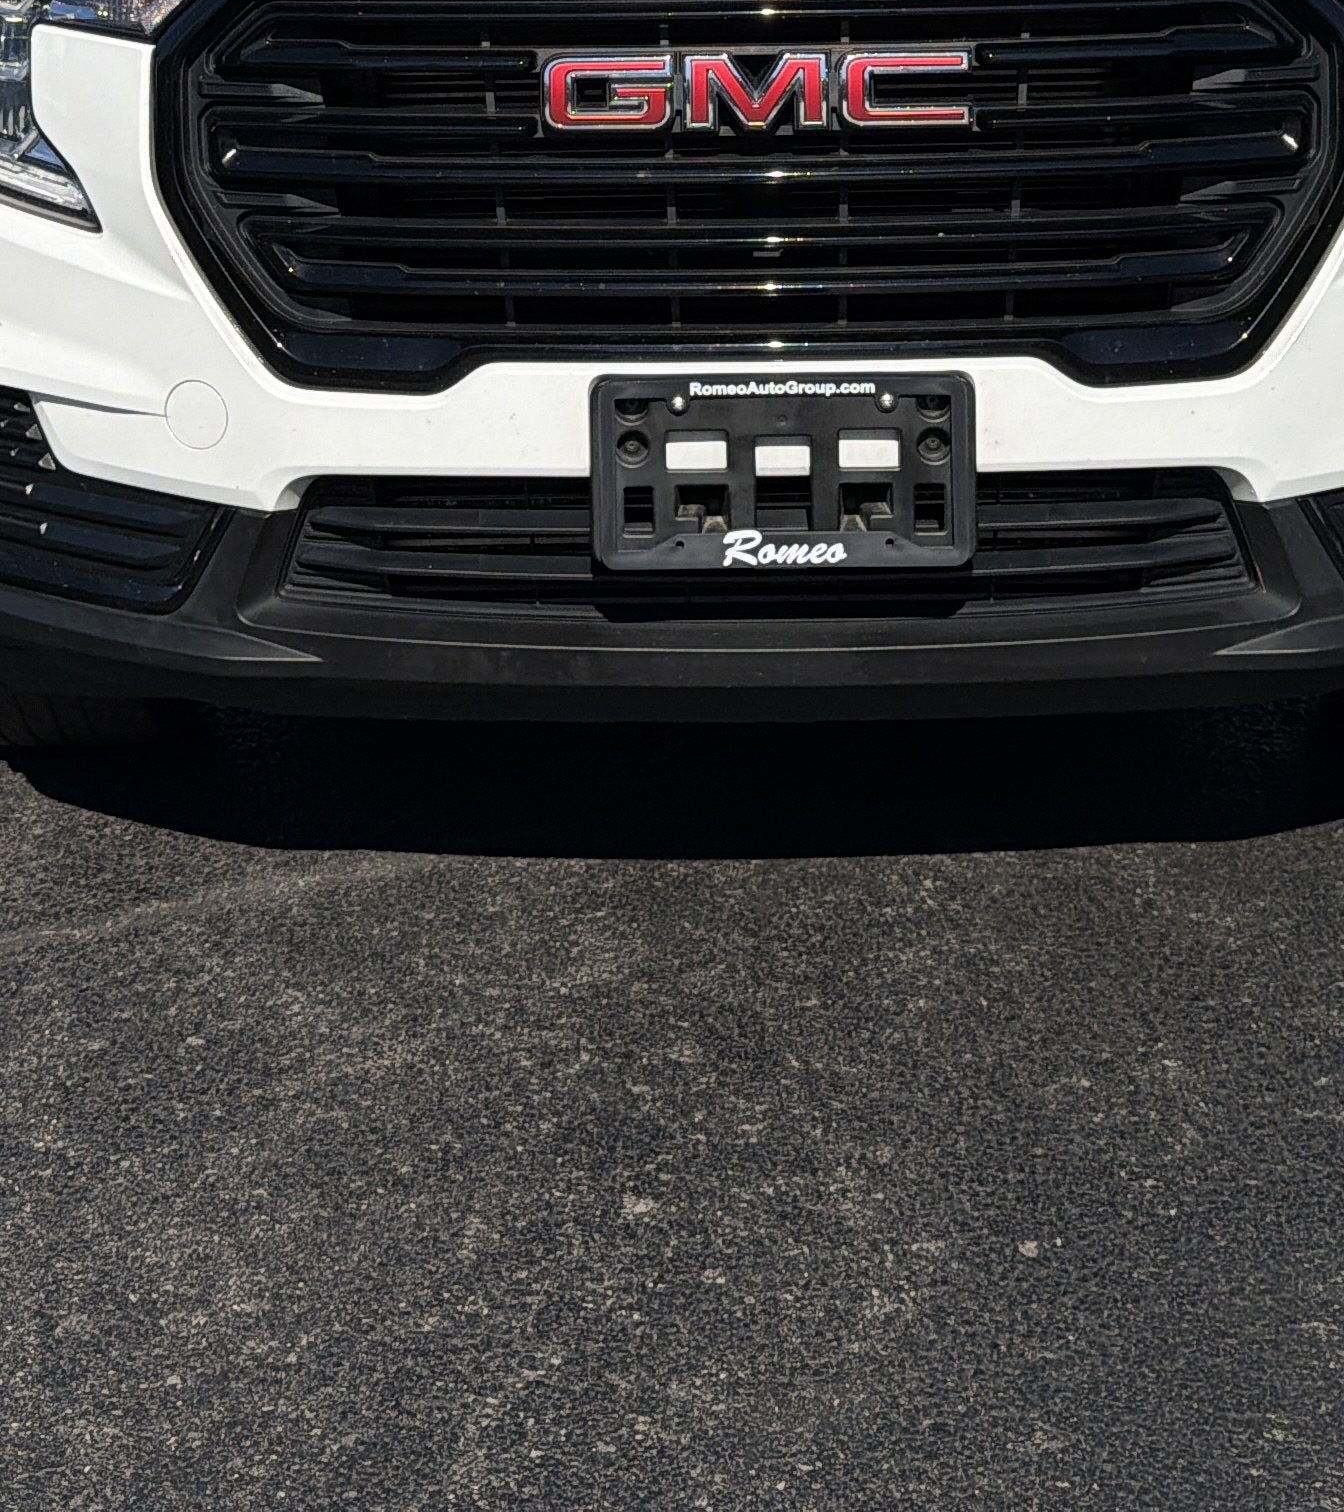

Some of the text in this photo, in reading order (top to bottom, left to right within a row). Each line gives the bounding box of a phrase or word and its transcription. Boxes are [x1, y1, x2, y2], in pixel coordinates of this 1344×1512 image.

[542, 50, 973, 134] GMC
[689, 380, 876, 397] RomeoAutoGroup.com
[722, 529, 848, 567] Romeo
